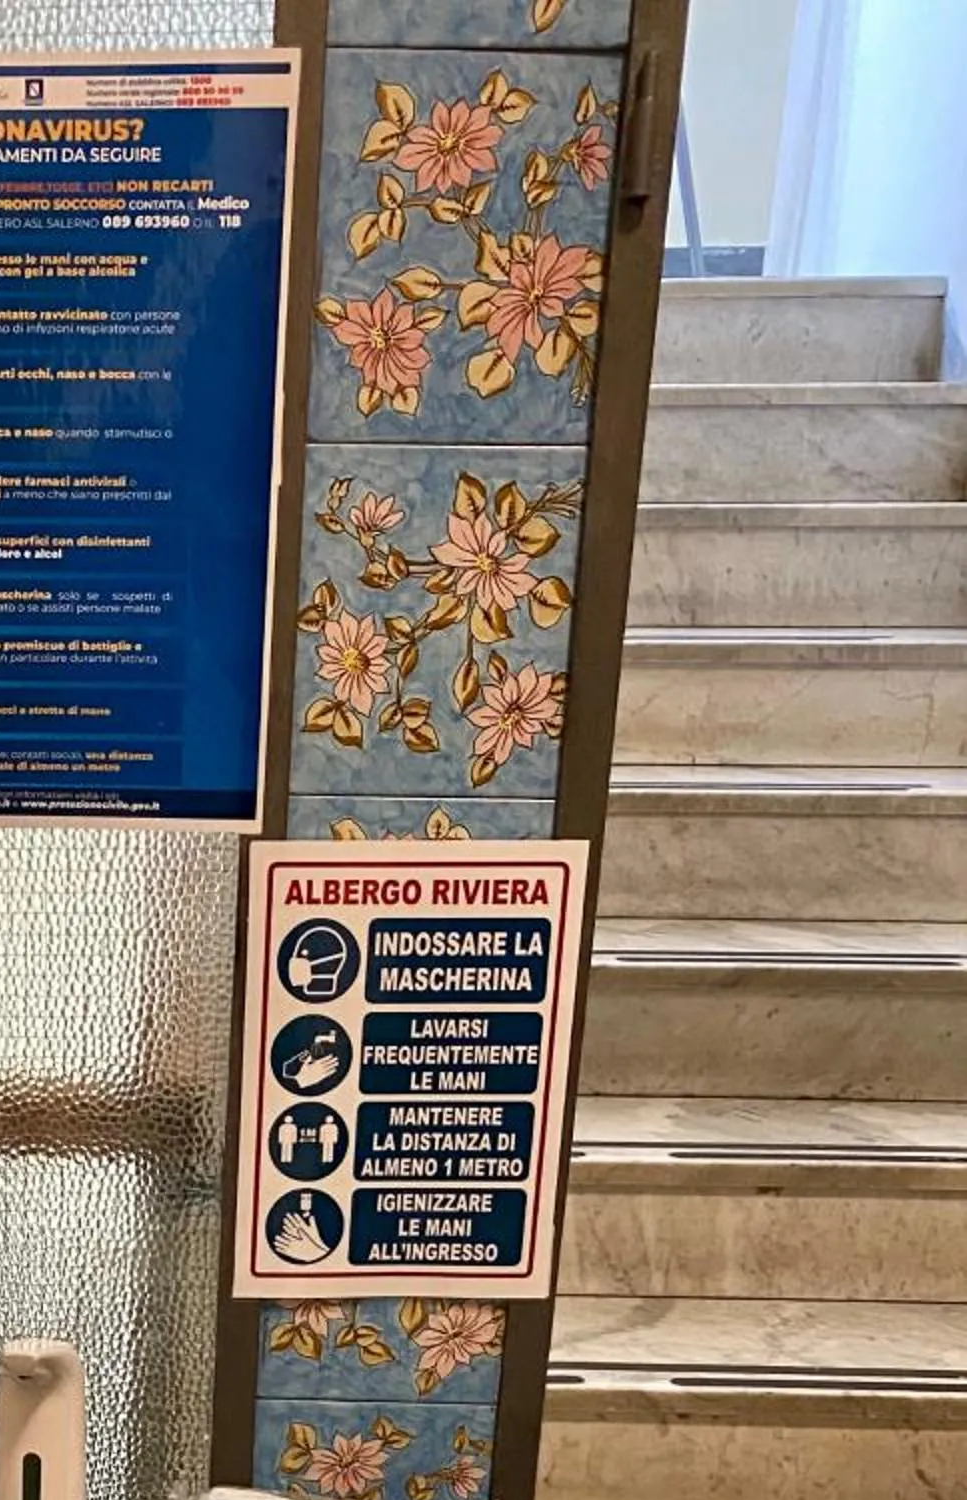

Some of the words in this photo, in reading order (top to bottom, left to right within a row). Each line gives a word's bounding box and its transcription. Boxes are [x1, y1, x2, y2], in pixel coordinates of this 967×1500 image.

[61, 148, 87, 162] DA
[90, 148, 161, 163] SEGUIRE
[117, 181, 148, 191] NON
[153, 181, 213, 191] RECARTI
[54, 199, 125, 210] SOCCORSO
[129, 200, 185, 210] CONTATTA
[198, 196, 249, 209] Medico
[24, 219, 42, 228] ASL
[47, 218, 99, 228] SALERNO
[103, 216, 131, 228] 089
[135, 216, 190, 228] 693960
[219, 216, 241, 227] 118
[25, 254, 37, 264] le
[41, 255, 71, 264] mani
[99, 257, 137, 267] acqua
[0, 268, 21, 276] con
[25, 266, 43, 278] gel
[57, 266, 85, 276] base
[89, 266, 135, 276] alcolica
[41, 310, 107, 320] ravvicinato
[111, 312, 131, 320] con
[135, 312, 181, 322] persone
[13, 324, 23, 333] di
[143, 324, 175, 334] acute
[18, 369, 54, 380] occhi,
[57, 371, 85, 379] naso
[99, 369, 135, 379] bocca
[138, 372, 159, 380] con
[25, 429, 53, 437] naso
[55, 428, 99, 440] quando
[25, 476, 70, 486] farmaci
[73, 476, 127, 486] antivirali
[47, 490, 68, 499] che
[53, 538, 73, 546] con
[77, 536, 151, 547] disinfettanti
[34, 550, 62, 559] alcol
[58, 590, 81, 600] solo
[112, 592, 156, 602] sospetti
[77, 605, 120, 615] persone
[123, 604, 161, 613] malate
[69, 640, 80, 650] di
[83, 641, 131, 653] bottiglie
[67, 705, 78, 715] di
[81, 708, 110, 716] mano
[285, 879, 422, 906] ALBERGO
[432, 879, 549, 906] RIVIERA
[374, 931, 507, 957] INDOSSARE
[514, 932, 543, 955] LA
[380, 967, 532, 992] MASCHERINA
[411, 1019, 488, 1039] LAVARSI
[362, 1044, 539, 1066] FREQUENTEMENTE
[410, 1071, 432, 1091] LE
[437, 1071, 486, 1092] MANI
[389, 1107, 503, 1127] MANTENERE
[372, 1132, 396, 1151] LA
[402, 1132, 491, 1152] DISTANZA
[497, 1132, 516, 1152] DI
[361, 1158, 438, 1177] ALMENO
[444, 1159, 453, 1176] 1
[458, 1158, 523, 1177] METRO
[376, 1193, 493, 1213] IGIENIZZARE
[398, 1218, 420, 1237] LE
[425, 1218, 472, 1237] MANI
[368, 1242, 499, 1262] ALL'INGRESSO
